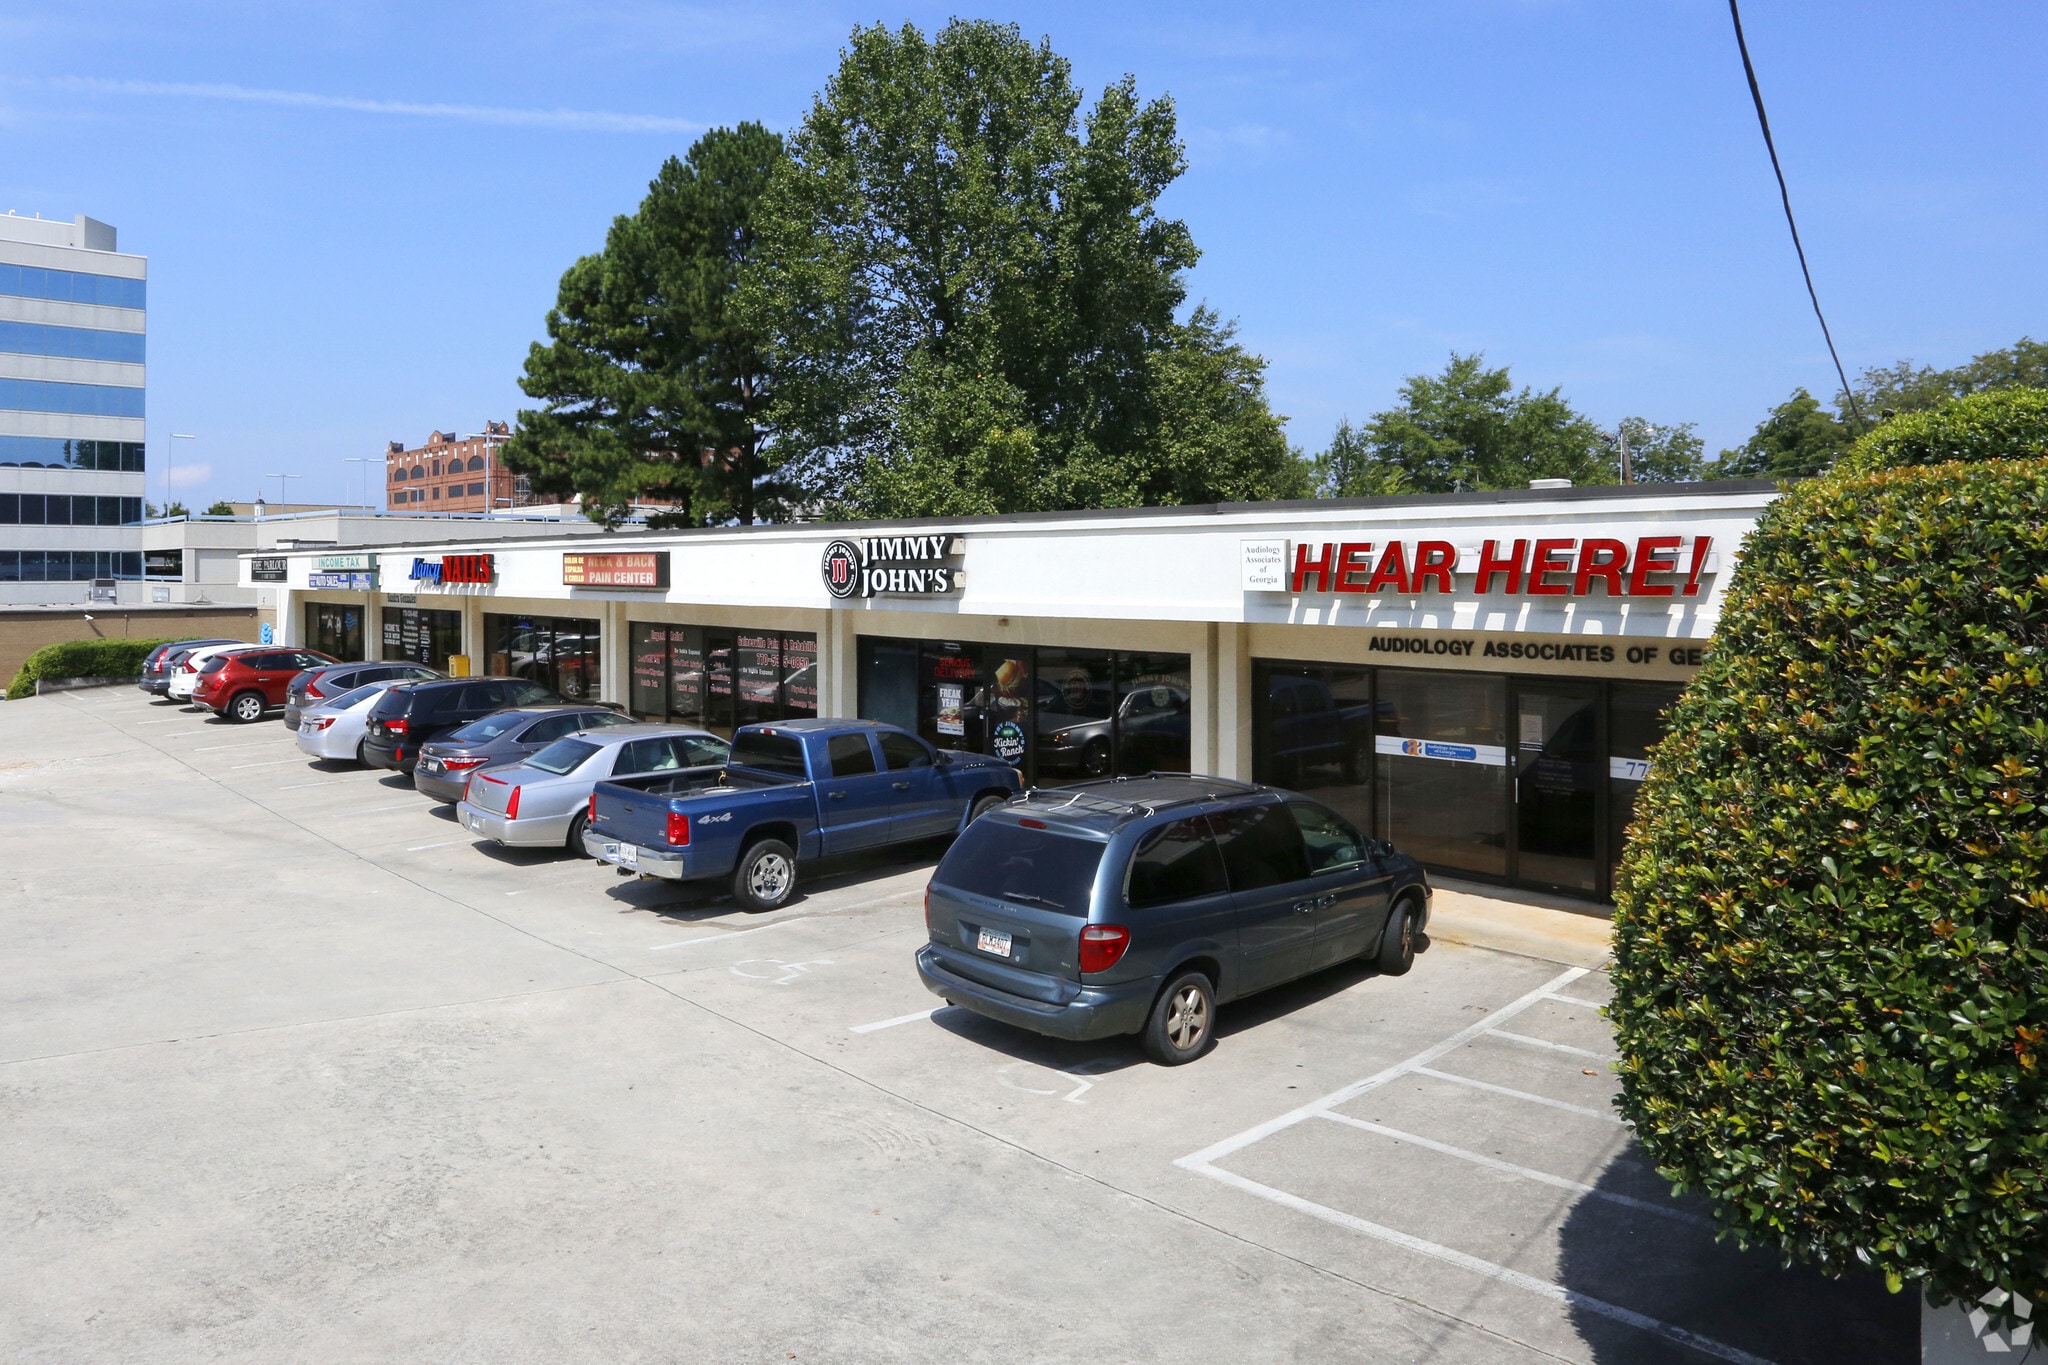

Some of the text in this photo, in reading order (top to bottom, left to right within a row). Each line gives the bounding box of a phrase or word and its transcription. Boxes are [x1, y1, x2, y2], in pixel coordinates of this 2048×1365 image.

[1245, 546, 1280, 555] Audiology
[252, 559, 287, 570] THE PARLOUR
[319, 556, 360, 568] INCOME TAX
[564, 556, 578, 564] DOLOR
[587, 555, 655, 567] NECK & BACK
[1291, 535, 1712, 597] HEAR HERE!
[408, 553, 492, 585] Nancy NAILS
[831, 558, 847, 583] JJ
[861, 536, 948, 598] JIMMY JOHN'S
[1259, 565, 1268, 573] of
[589, 572, 654, 584] PAIN CENTER
[1249, 575, 1278, 585] Georgia
[1369, 637, 1474, 656] AUDIOLOGY
[1483, 641, 1615, 662] ASSOCIATES
[1626, 647, 1658, 664] OF
[940, 657, 971, 668] SERIOUS
[934, 667, 977, 679] DELIVERY
[1131, 674, 1160, 687] JIMMY
[940, 688, 961, 699] FREAK
[941, 698, 960, 708] YEAH
[994, 722, 1004, 736] TRY
[993, 736, 1019, 748] Kickin'
[1000, 744, 1025, 757] Ranch
[697, 811, 733, 825] 4x4
